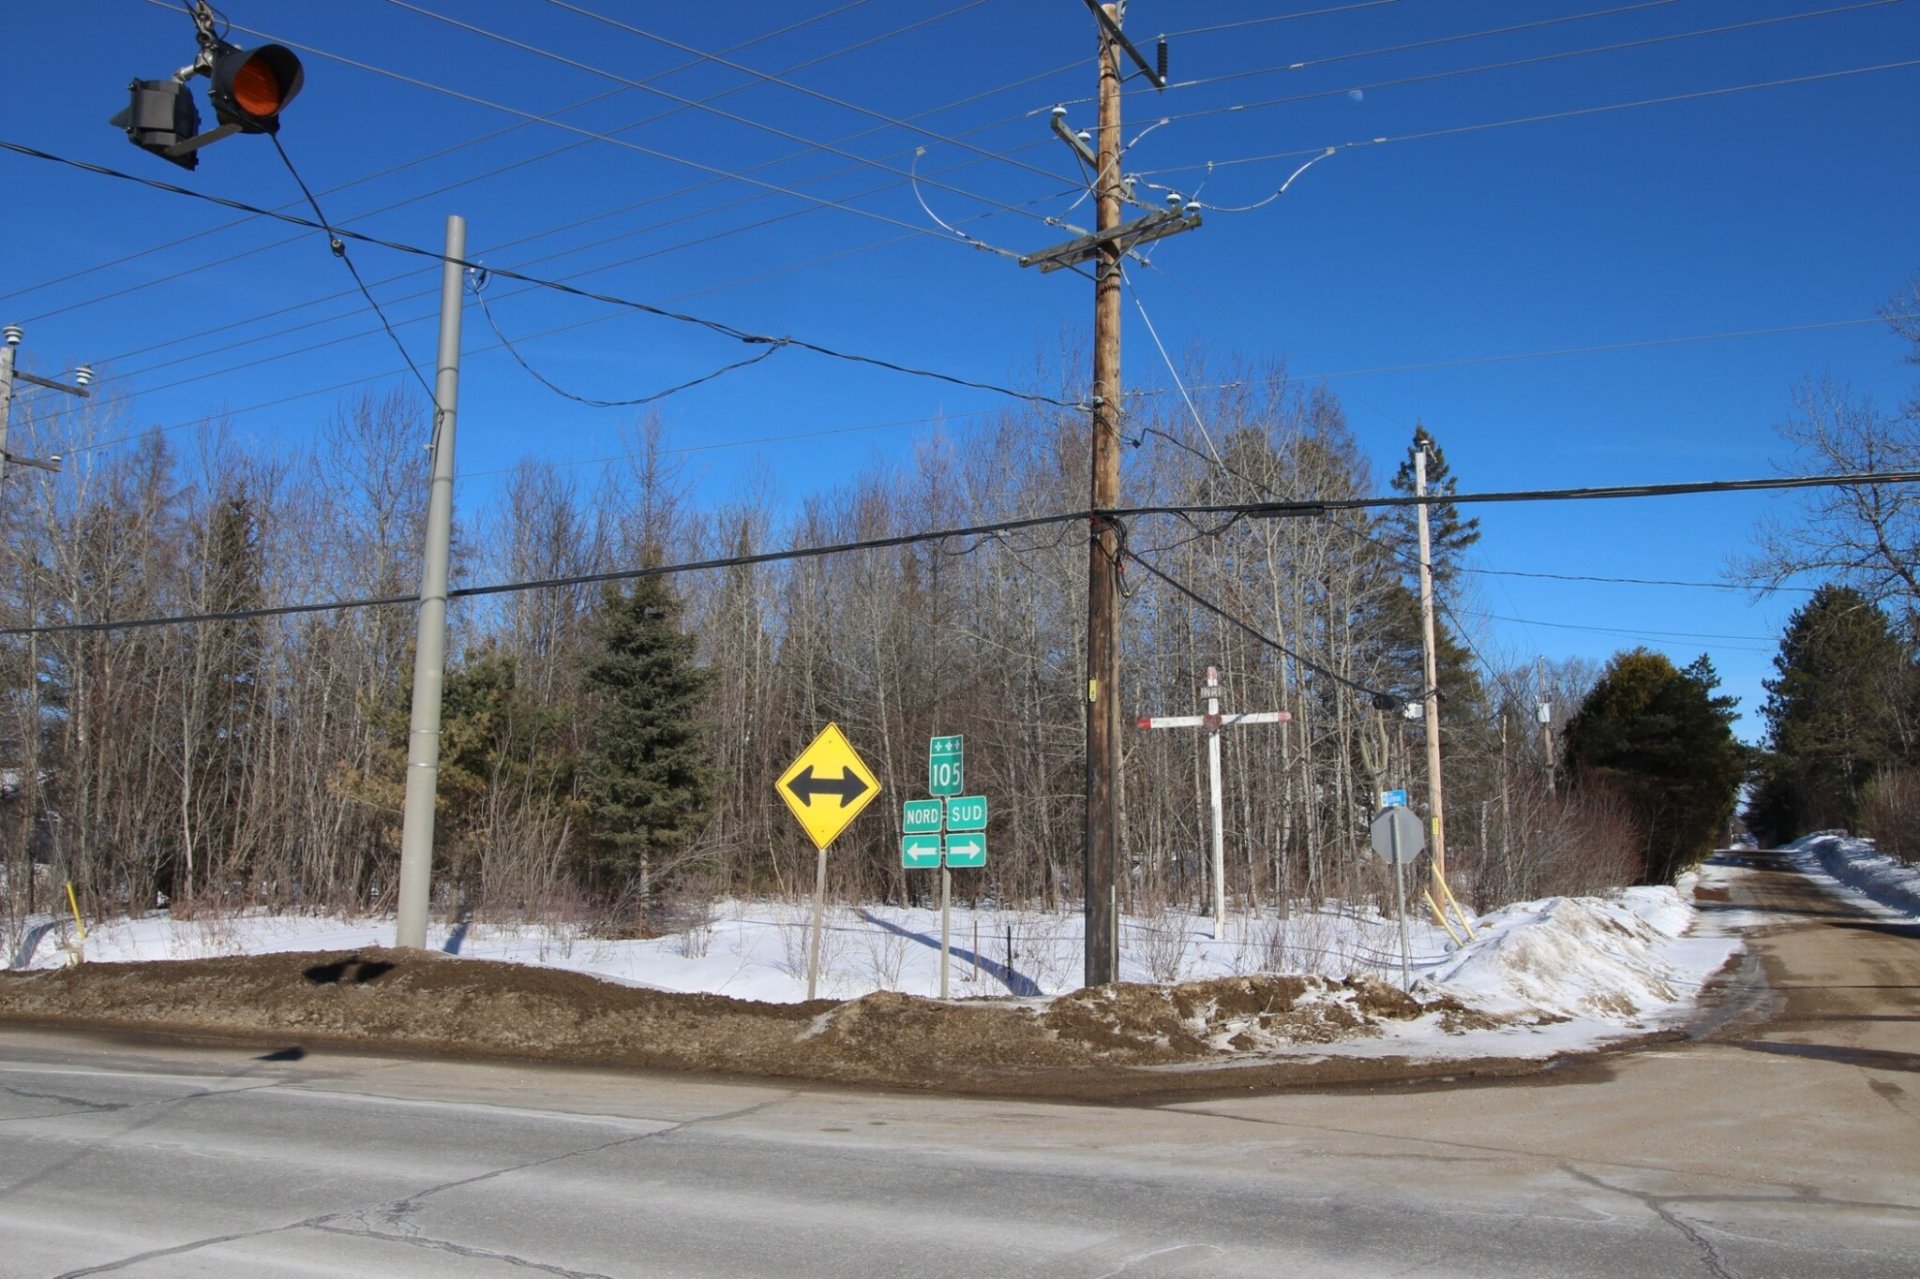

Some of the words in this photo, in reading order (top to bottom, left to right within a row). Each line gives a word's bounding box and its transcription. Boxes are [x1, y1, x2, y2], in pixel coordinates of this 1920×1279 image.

[933, 762, 960, 787] 105
[906, 808, 938, 825] NORD
[952, 805, 982, 822] SUD
